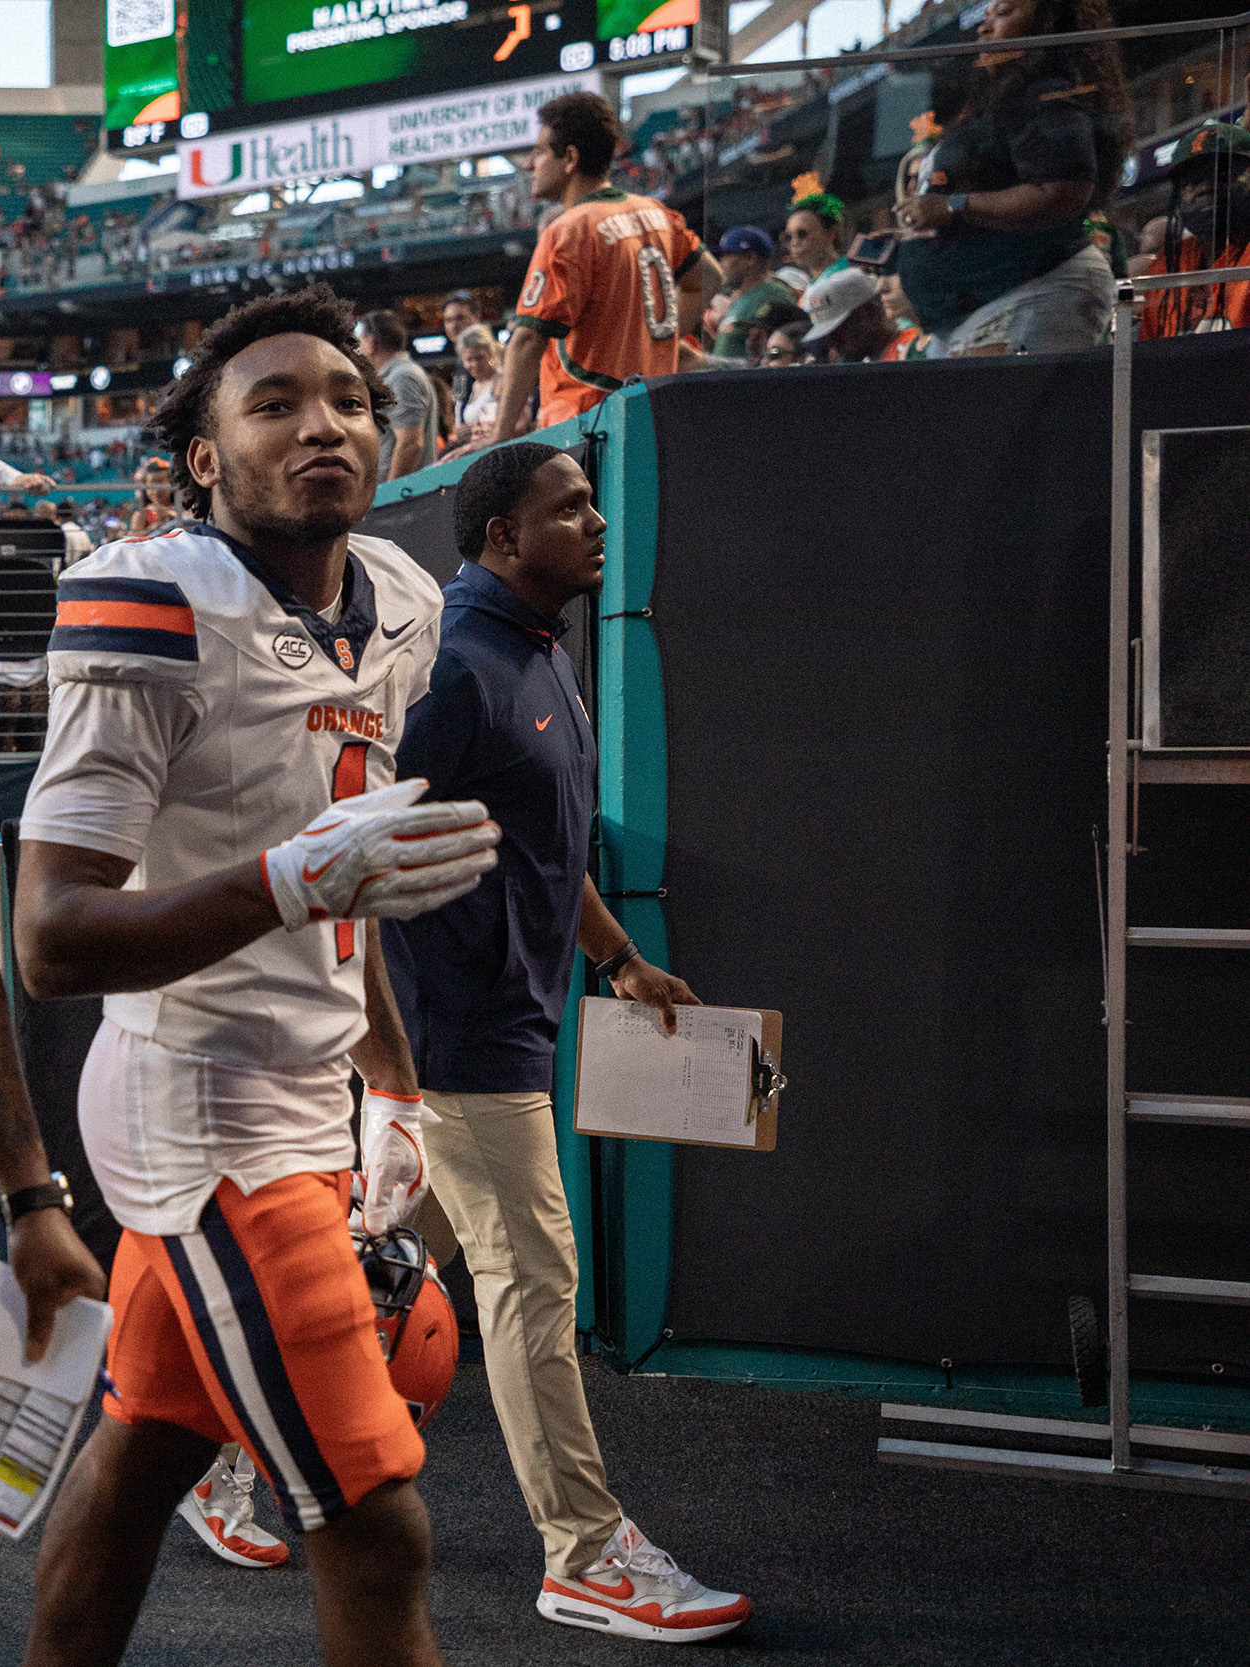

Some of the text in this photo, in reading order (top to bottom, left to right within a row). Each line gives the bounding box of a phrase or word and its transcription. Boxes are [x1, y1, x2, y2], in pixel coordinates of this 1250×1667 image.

[287, 1, 468, 53] PRESENTING SPONSOR
[654, 25, 688, 54] PM
[389, 101, 488, 133] UNIVERSITY
[494, 94, 515, 115] OF
[389, 119, 529, 155] HEALTH SYSTEM
[523, 270, 546, 307] 0
[639, 246, 679, 341] 0
[280, 640, 307, 655] ACC
[335, 637, 354, 670] S
[306, 704, 384, 738] ORANGE
